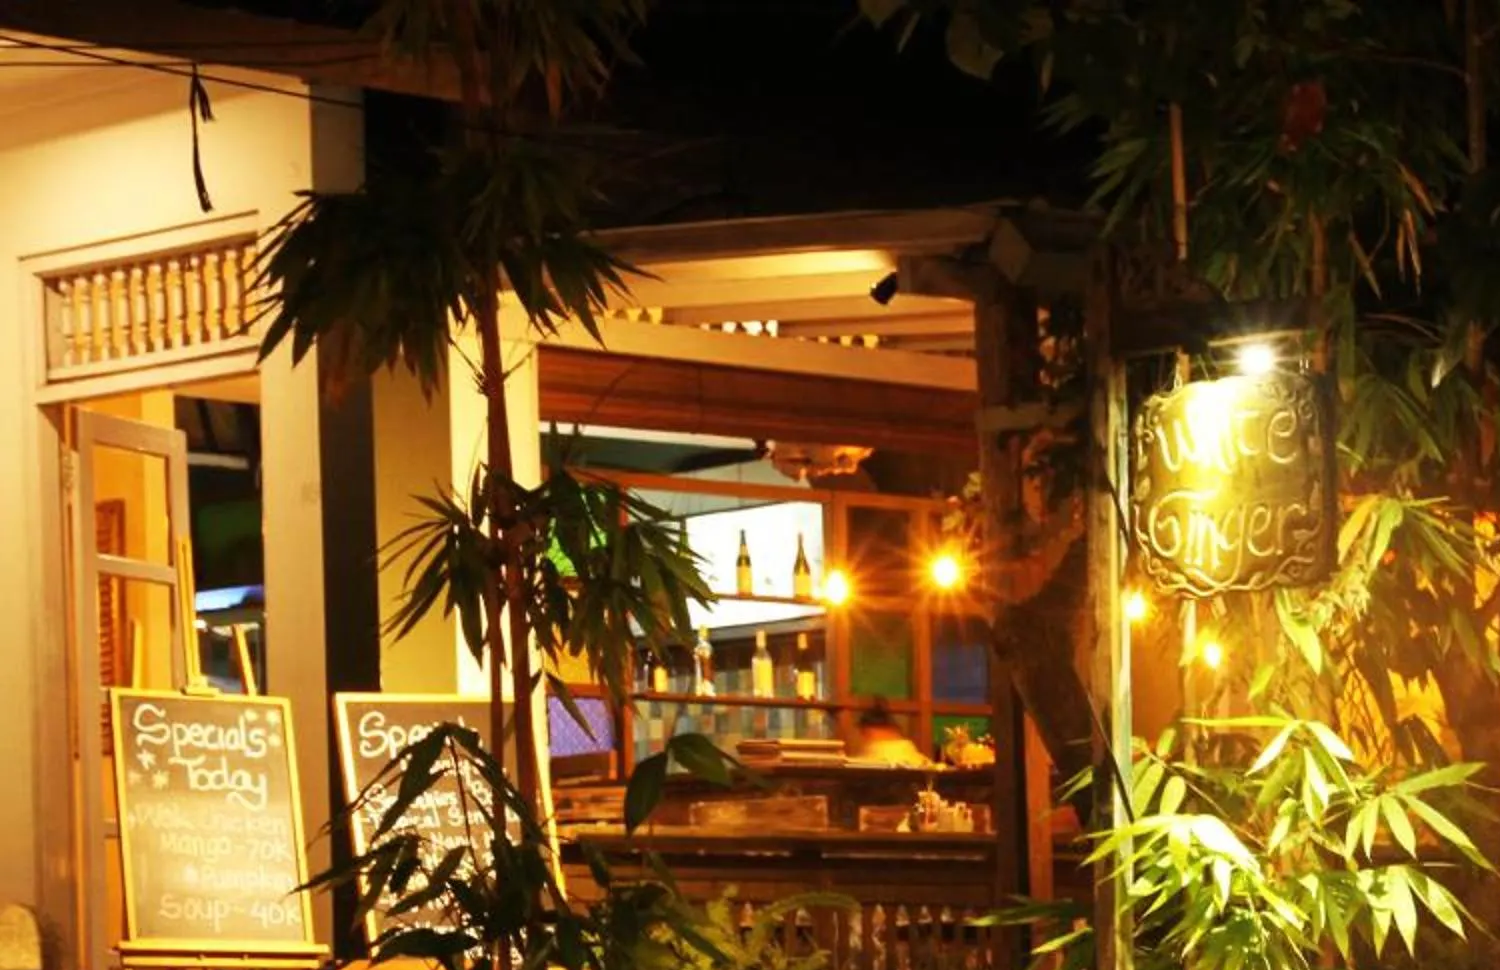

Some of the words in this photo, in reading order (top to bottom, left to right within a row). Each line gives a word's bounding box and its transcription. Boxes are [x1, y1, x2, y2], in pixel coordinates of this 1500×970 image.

[1149, 489, 1308, 590] Ginger
[132, 702, 268, 759] Specials
[167, 754, 268, 812] Today
[158, 892, 231, 933] Soup
[250, 901, 301, 930] 40K
